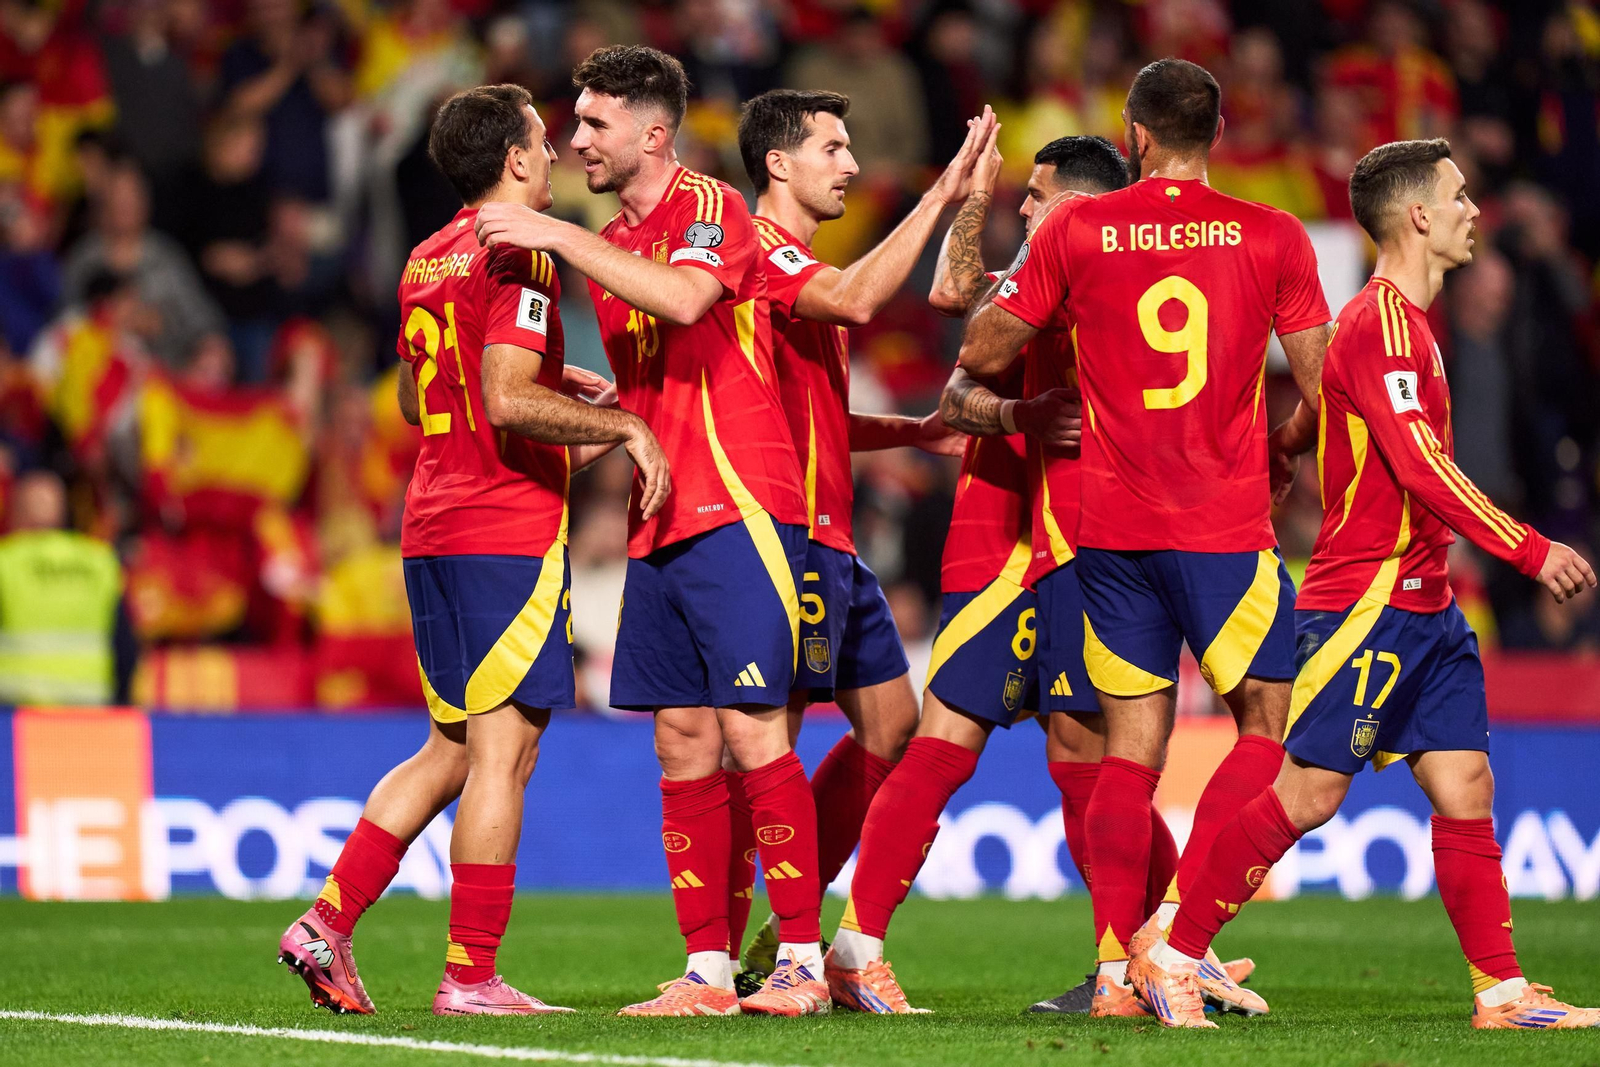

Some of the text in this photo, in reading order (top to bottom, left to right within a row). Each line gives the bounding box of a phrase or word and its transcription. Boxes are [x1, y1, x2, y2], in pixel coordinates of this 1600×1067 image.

[1102, 220, 1242, 253] B. IGLESIAS
[626, 309, 659, 363] 10
[1137, 275, 1208, 409] 9
[404, 302, 476, 436] 21
[800, 572, 826, 625] 5
[1011, 607, 1037, 660] 8
[1351, 649, 1401, 709] 17
